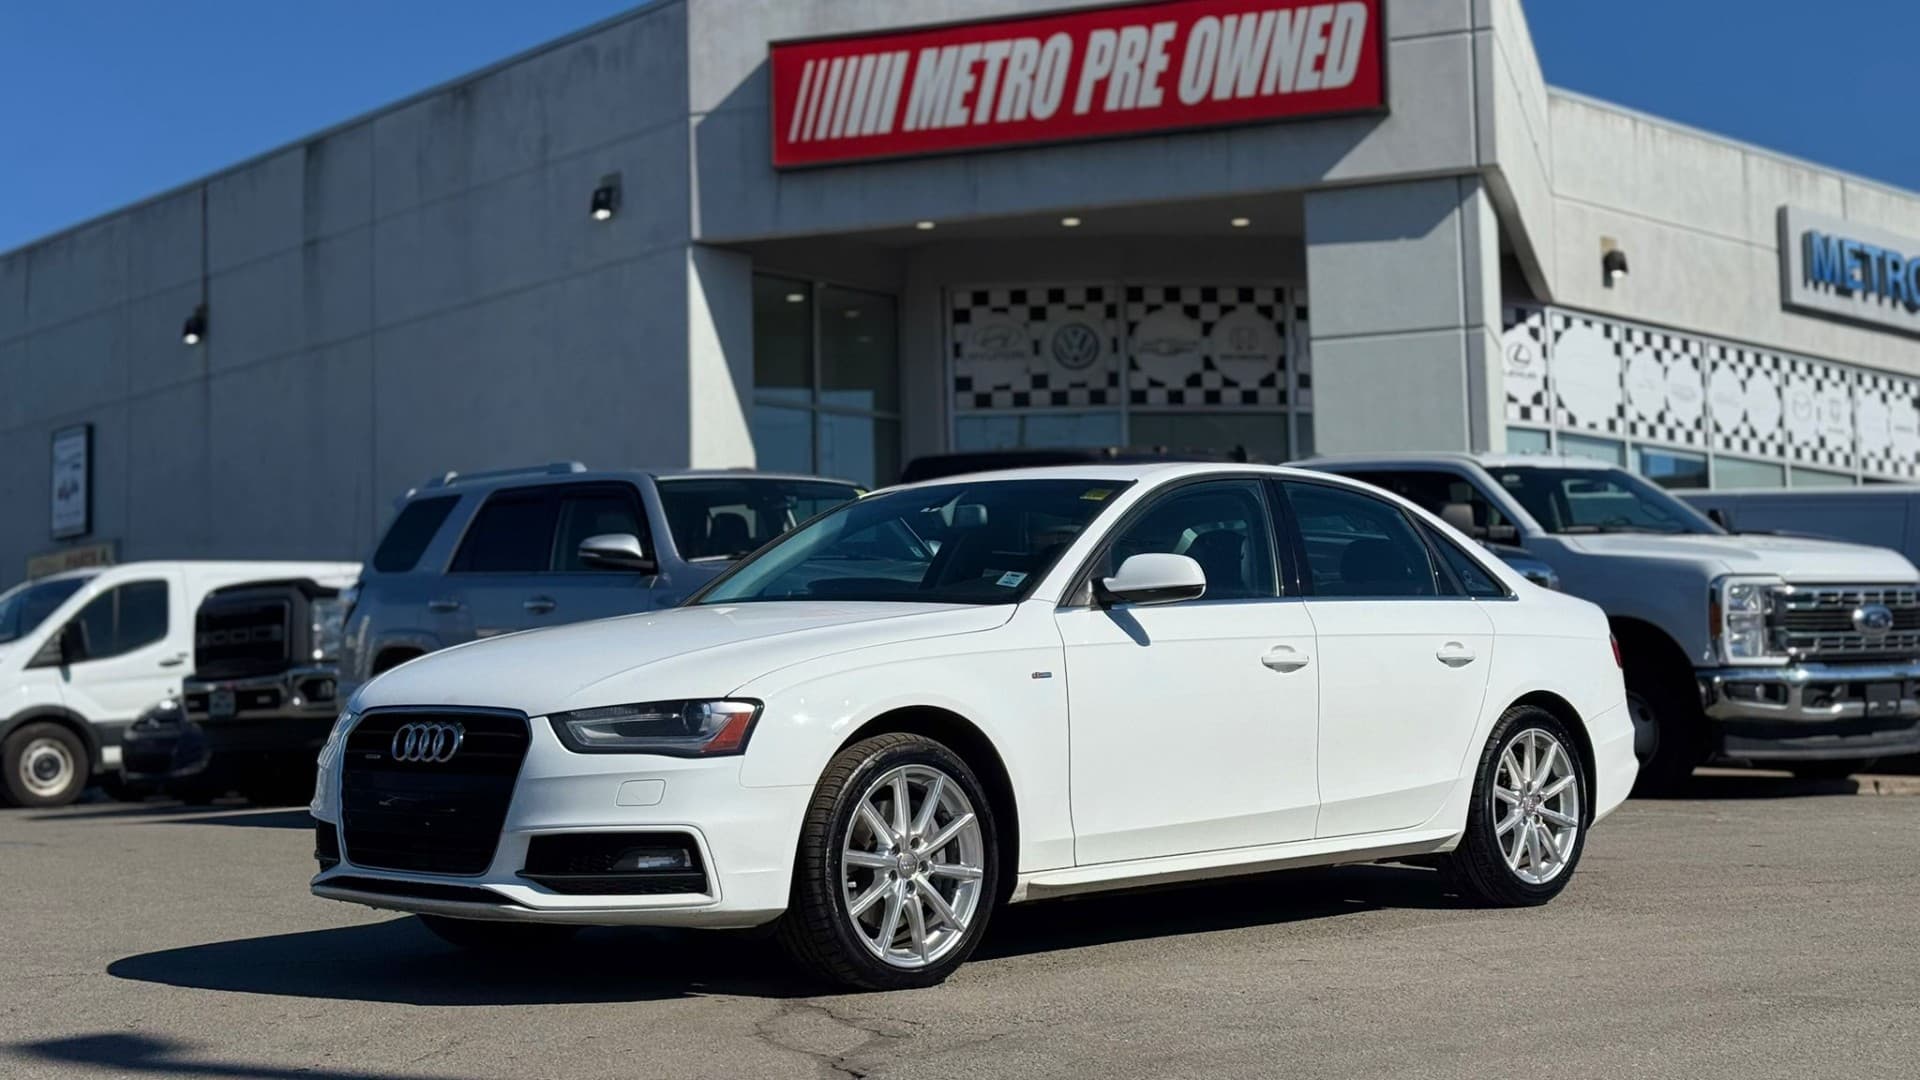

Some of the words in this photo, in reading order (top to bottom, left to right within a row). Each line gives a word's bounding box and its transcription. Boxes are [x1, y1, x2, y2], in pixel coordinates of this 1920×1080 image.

[903, 32, 1073, 131] METRO
[1073, 21, 1177, 115] PRE
[1178, 2, 1367, 106] OWNED
